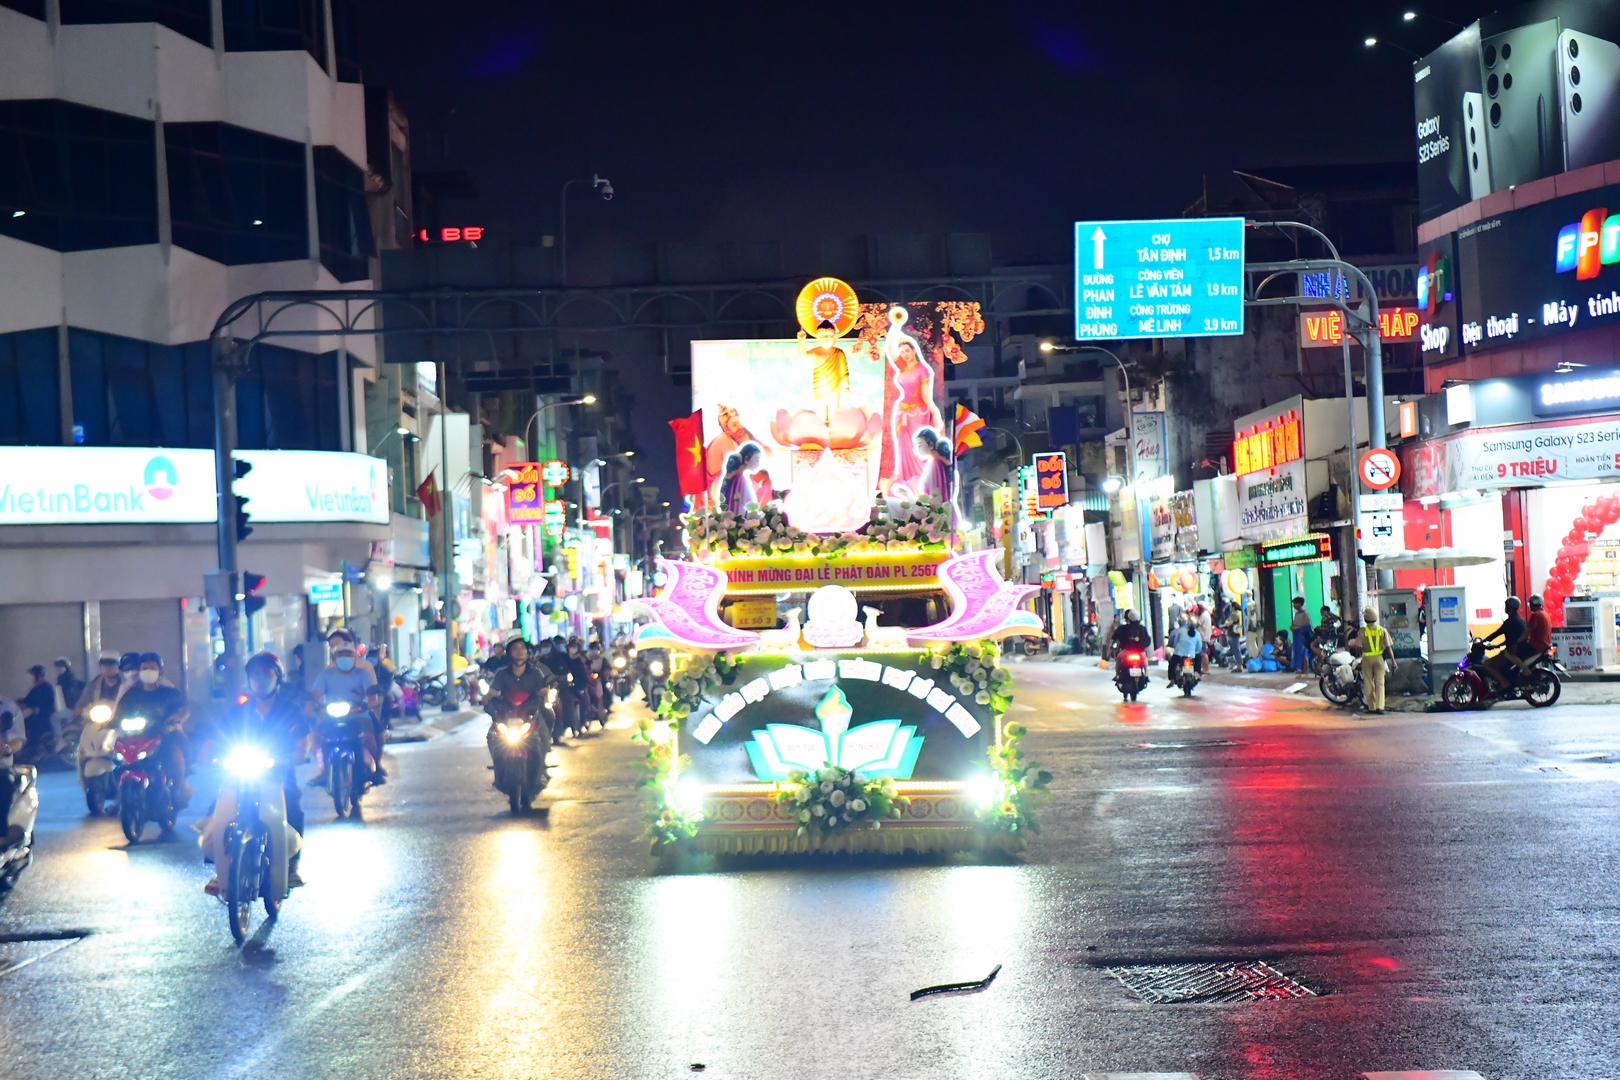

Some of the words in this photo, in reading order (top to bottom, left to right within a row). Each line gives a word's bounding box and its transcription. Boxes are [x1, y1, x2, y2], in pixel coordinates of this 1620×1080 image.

[1417, 115, 1441, 140] Galaxy
[1418, 144, 1431, 164] S23
[1429, 134, 1450, 156] Series
[1151, 232, 1171, 246] CHỢ
[1556, 225, 1620, 264] FPT
[1136, 246, 1158, 262] TÂN
[1160, 248, 1186, 264] ĐỊNH
[1223, 247, 1240, 260] km
[1083, 271, 1115, 286] ĐƯỜNG
[1138, 268, 1162, 281] CÔNG
[1163, 267, 1184, 280] VIÊN
[1083, 288, 1115, 303] PHAN
[1129, 283, 1144, 298] LÊ
[1146, 281, 1168, 298] VĂN
[1169, 281, 1192, 297] TÁM
[1221, 283, 1238, 296] km
[1085, 303, 1113, 320] ĐÌNH
[1130, 303, 1155, 316] CÔNG
[1155, 302, 1191, 316] TRƯỜNG
[1139, 317, 1155, 332] MÊ
[1156, 319, 1182, 332] LINH
[1220, 317, 1238, 331] km
[1306, 310, 1343, 344] VIỆ
[1377, 307, 1419, 338] HÁP
[1462, 321, 1483, 347] Điện
[1486, 312, 1519, 339] thoại
[1543, 300, 1579, 328] Máy
[1588, 290, 1620, 318] tính
[1080, 320, 1118, 337] PHÙNG
[1420, 322, 1449, 354] Shop
[1483, 440, 1532, 453] Samsung
[1534, 434, 1574, 450] Galaxy
[1576, 431, 1595, 445] S23
[1497, 463, 1507, 478] 9
[1509, 455, 1557, 479] TRIỆU
[1575, 454, 1595, 464] HOÀN
[1041, 471, 1062, 490] SỐ
[513, 483, 536, 502] SỐ
[726, 566, 755, 583] KÍNH
[757, 566, 792, 582] MỪNG
[794, 567, 815, 583] ĐẠI
[817, 562, 831, 580] LỄ
[834, 564, 864, 582] PHẬT
[866, 562, 890, 579] ĐẢN
[893, 565, 908, 578] PL
[910, 563, 939, 577] 2567
[752, 615, 764, 625] SỐ
[1568, 646, 1593, 657] 50%
